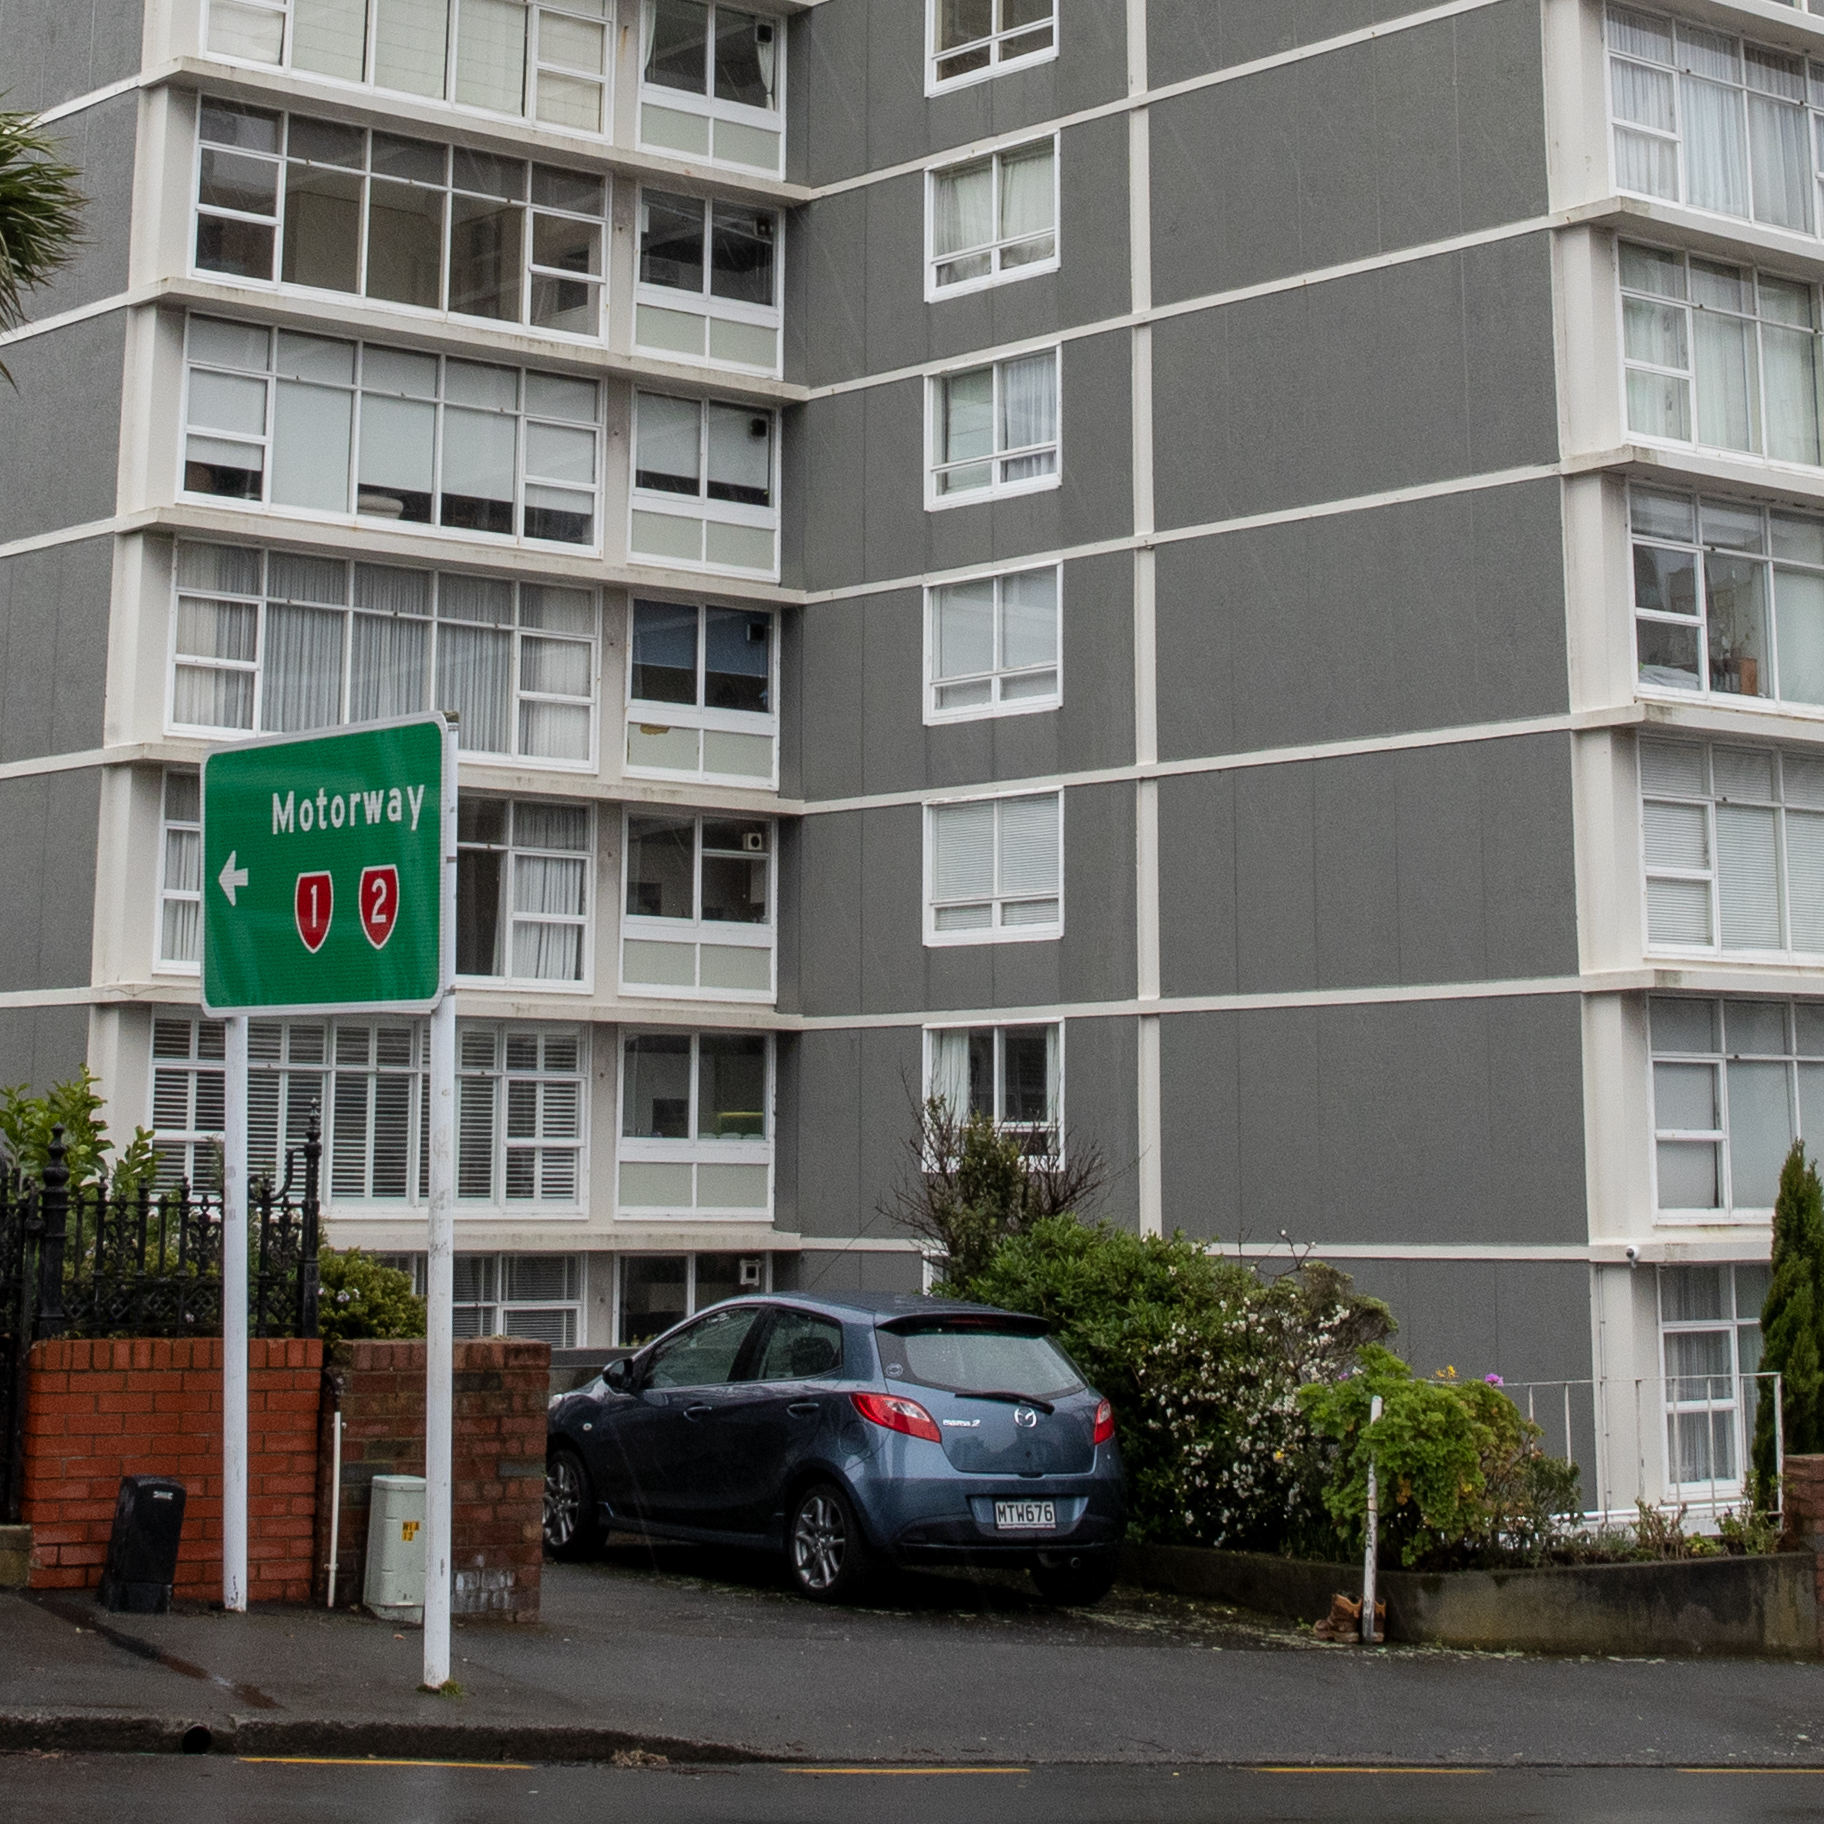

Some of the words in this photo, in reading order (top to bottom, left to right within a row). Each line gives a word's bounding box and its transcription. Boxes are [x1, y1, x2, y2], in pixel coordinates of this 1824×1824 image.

[272, 784, 425, 835] Motorway
[310, 884, 318, 928] 1
[371, 878, 387, 924] 2
[997, 1504, 1053, 1522] MTW676
